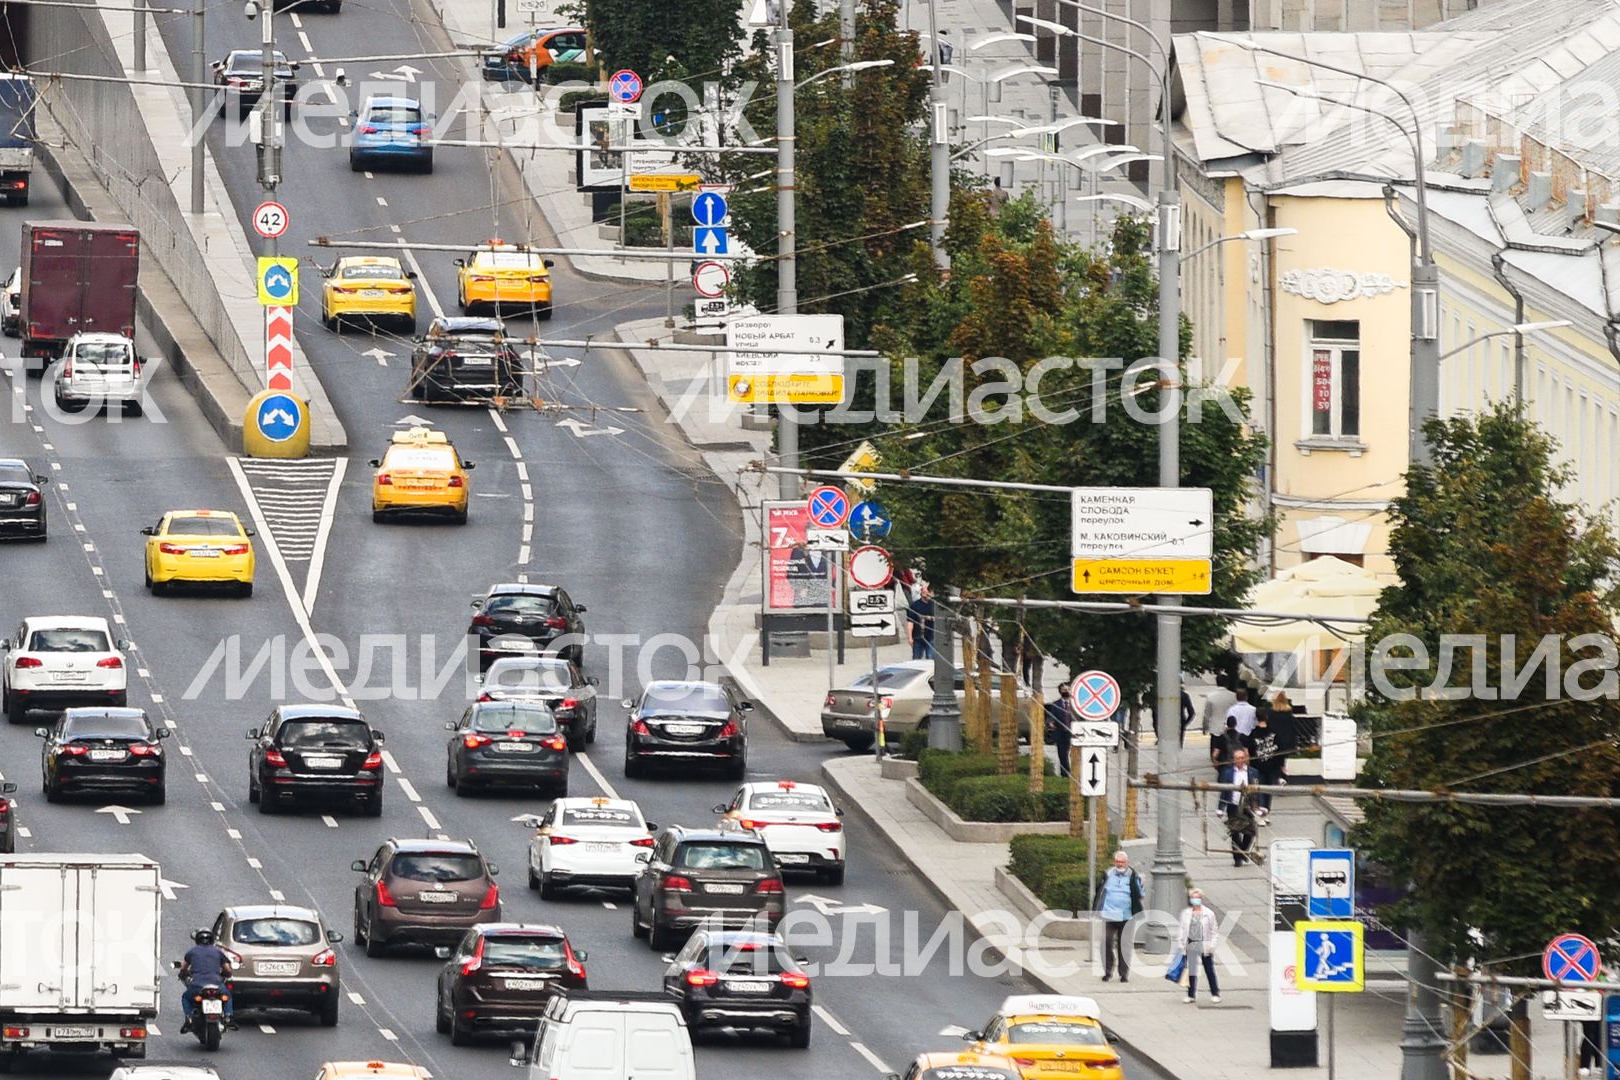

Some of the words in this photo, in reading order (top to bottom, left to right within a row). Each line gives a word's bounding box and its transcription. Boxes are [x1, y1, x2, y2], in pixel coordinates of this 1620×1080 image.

[1080, 495, 1136, 504] КАМЕННАЯ
[1080, 506, 1130, 515] СЛОБОДА
[1094, 531, 1168, 541] КАКОВИНСКИЙ
